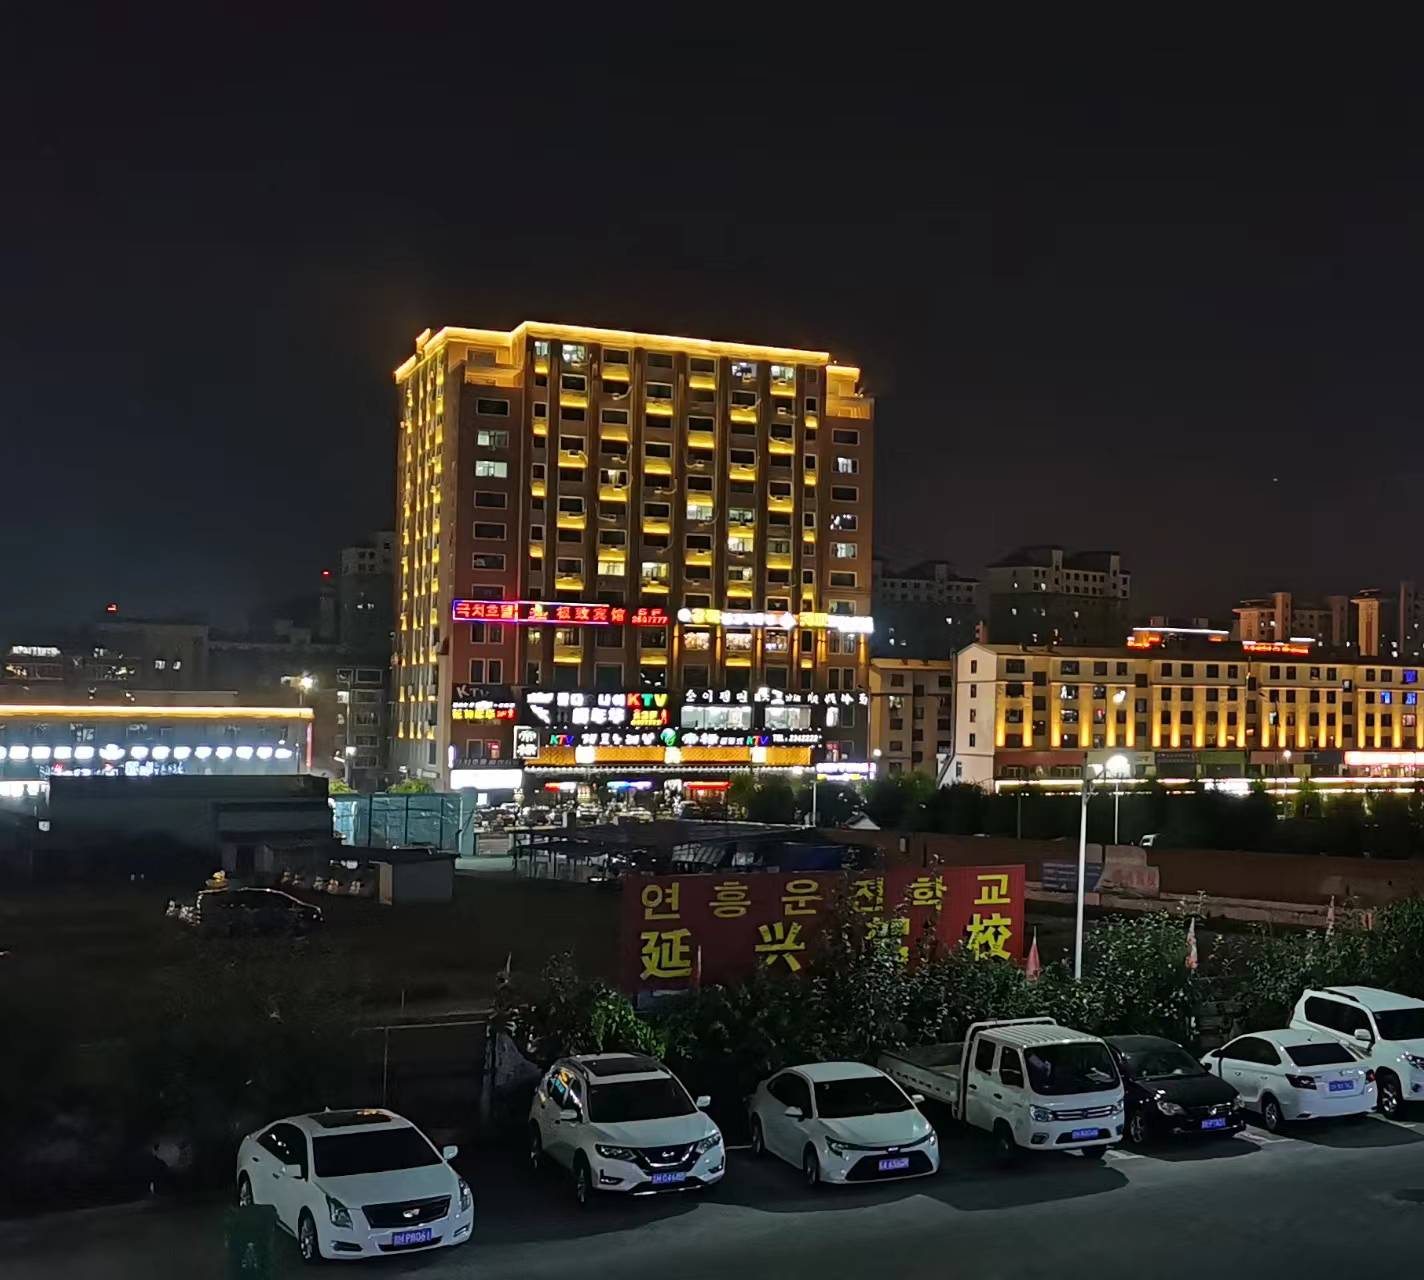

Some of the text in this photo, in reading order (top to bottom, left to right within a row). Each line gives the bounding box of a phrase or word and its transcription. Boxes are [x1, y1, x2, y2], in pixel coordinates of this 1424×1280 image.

[627, 693, 668, 707] KTV
[549, 734, 574, 746] KTV
[746, 735, 769, 746] KTV
